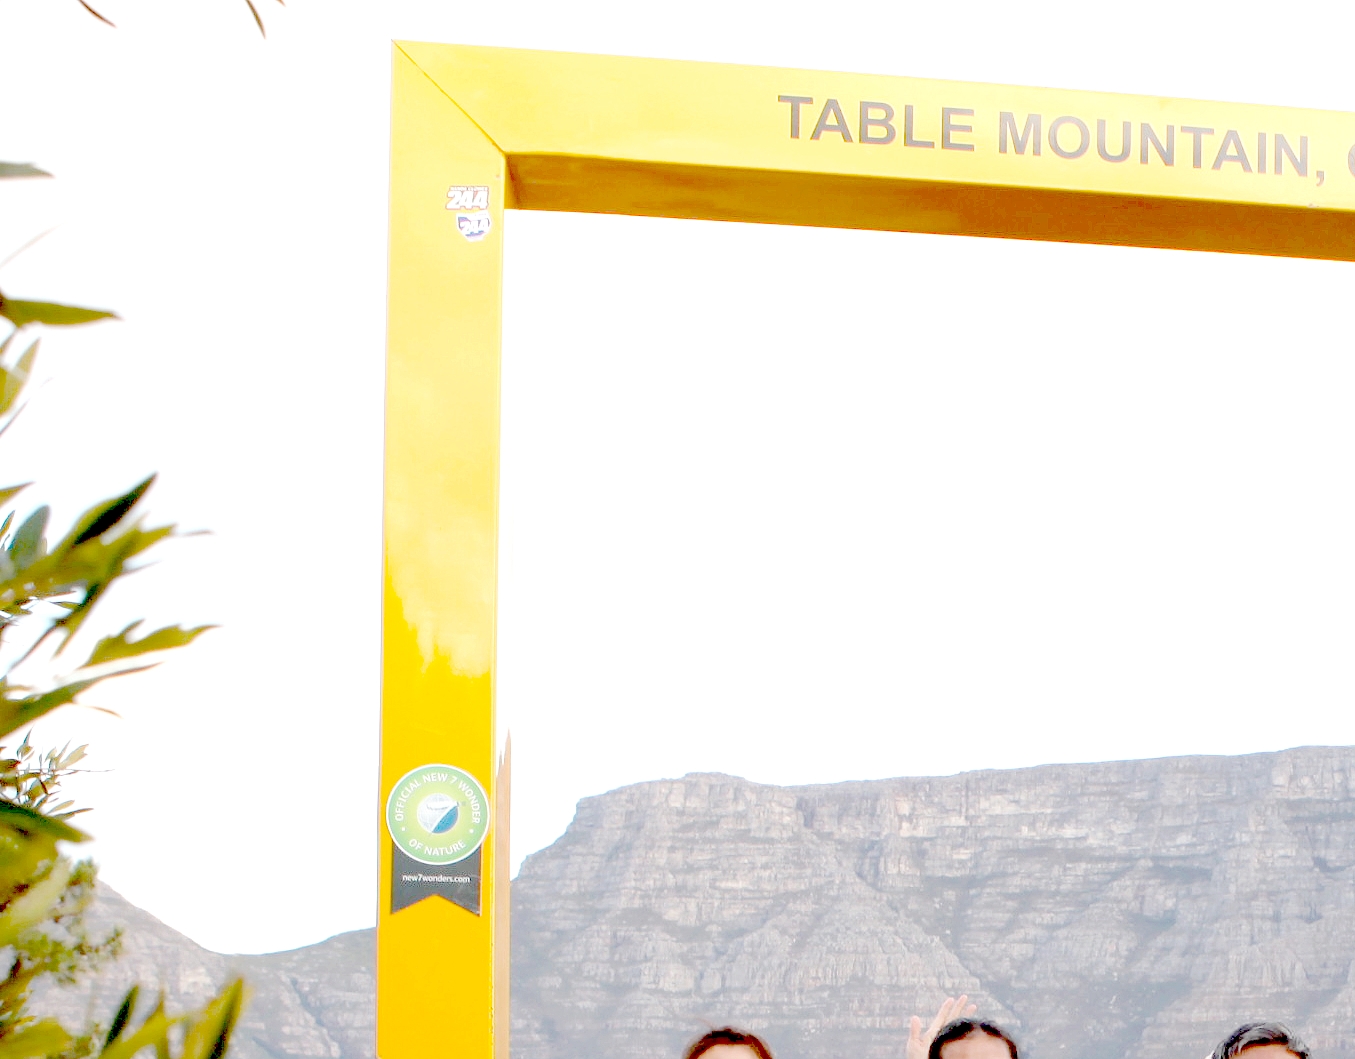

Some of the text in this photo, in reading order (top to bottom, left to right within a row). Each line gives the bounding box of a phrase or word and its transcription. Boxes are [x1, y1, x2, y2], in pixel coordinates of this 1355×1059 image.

[777, 94, 975, 152] TABLE
[999, 111, 1326, 187] MOUNTAIN,
[445, 190, 489, 210] 244
[394, 772, 481, 824] OFFICIAL NEW 7 WONDER
[408, 838, 466, 856] OF NATURE
[402, 873, 471, 884] new7wonders.com
